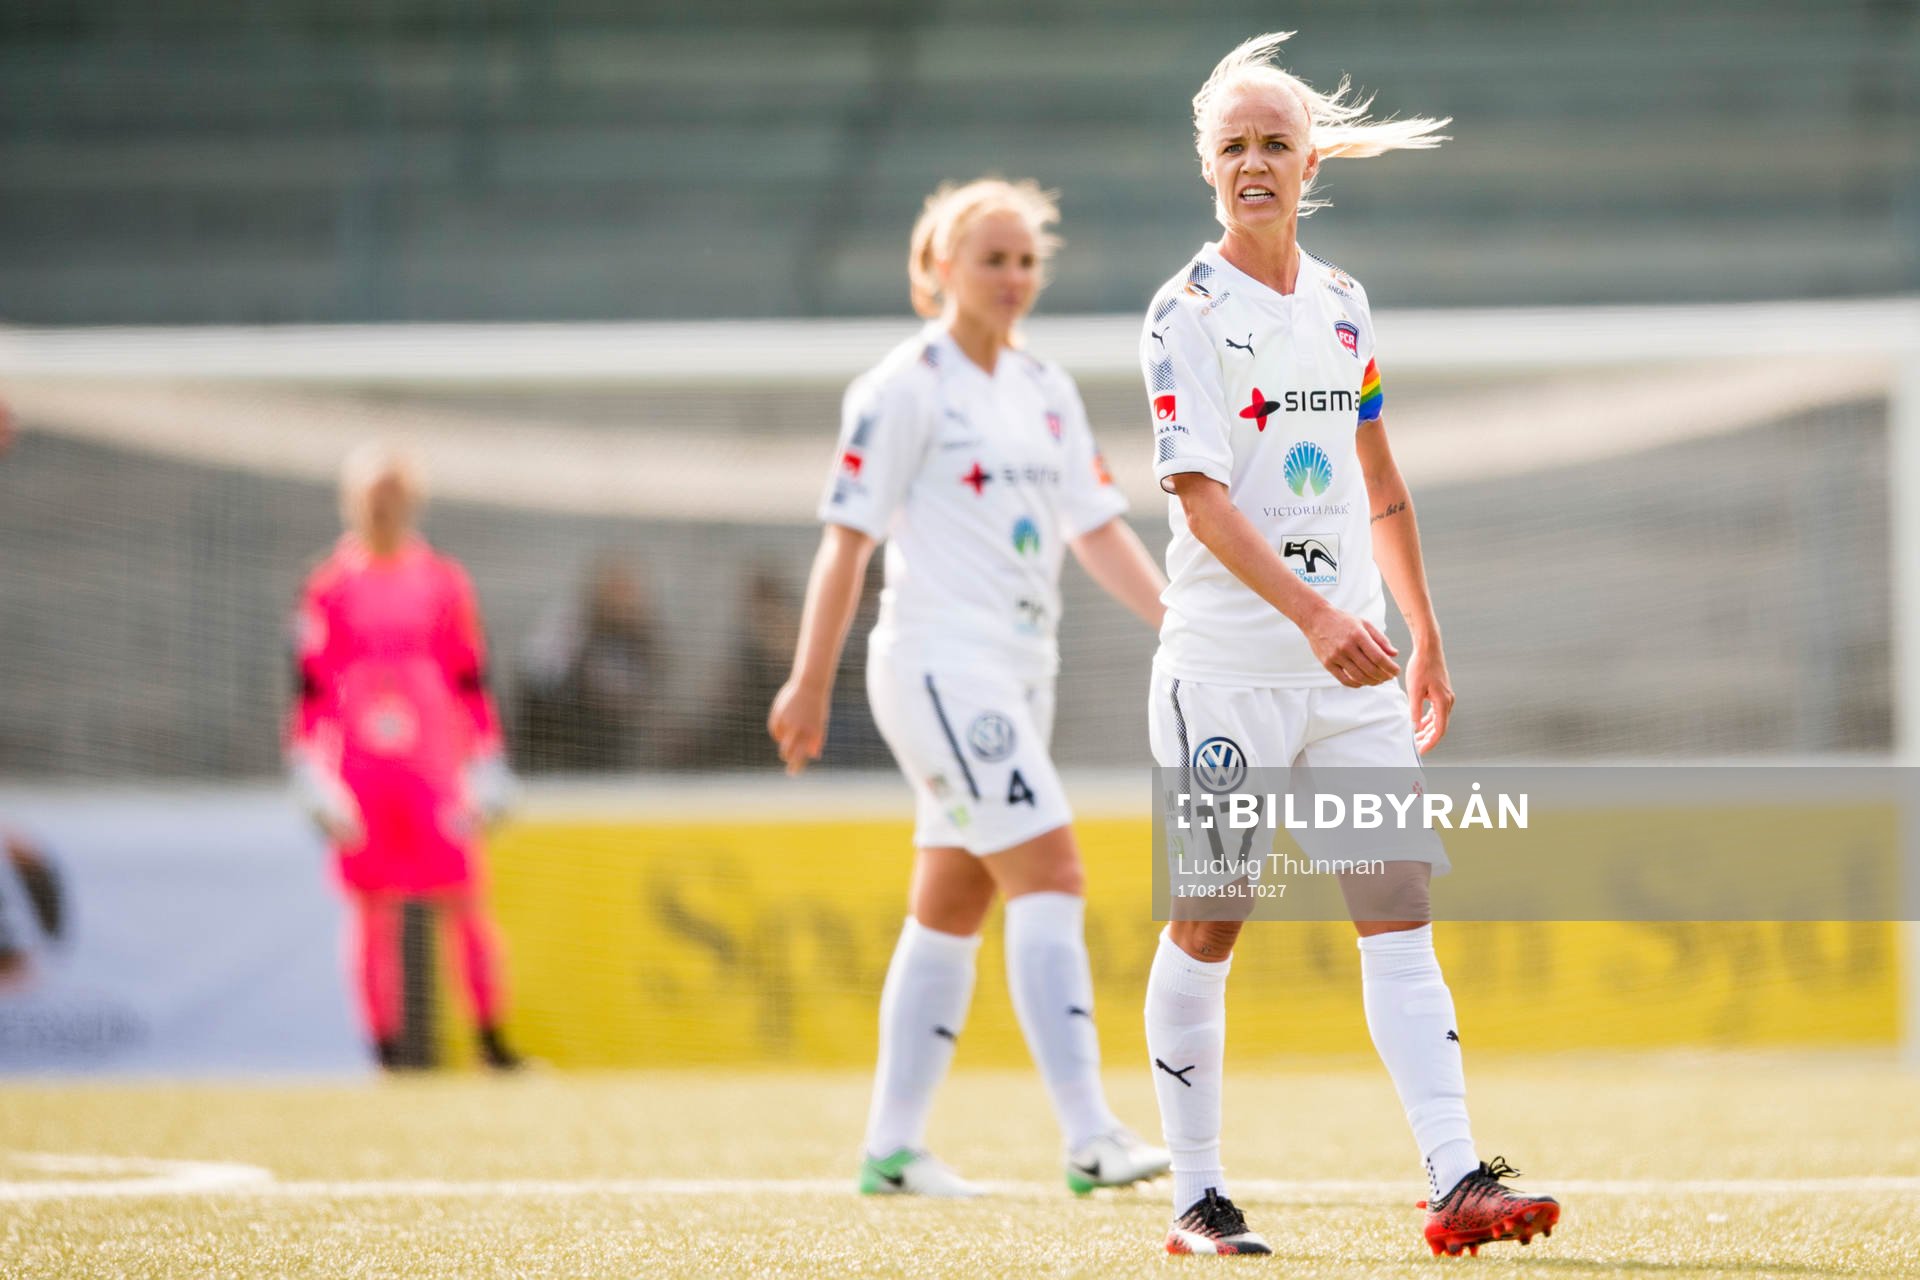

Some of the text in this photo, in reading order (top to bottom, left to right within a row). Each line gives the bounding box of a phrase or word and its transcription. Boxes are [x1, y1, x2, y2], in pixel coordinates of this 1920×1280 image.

[1338, 330, 1355, 346] FCR
[1263, 505, 1321, 517] VICTORIA
[1007, 768, 1036, 806] 4
